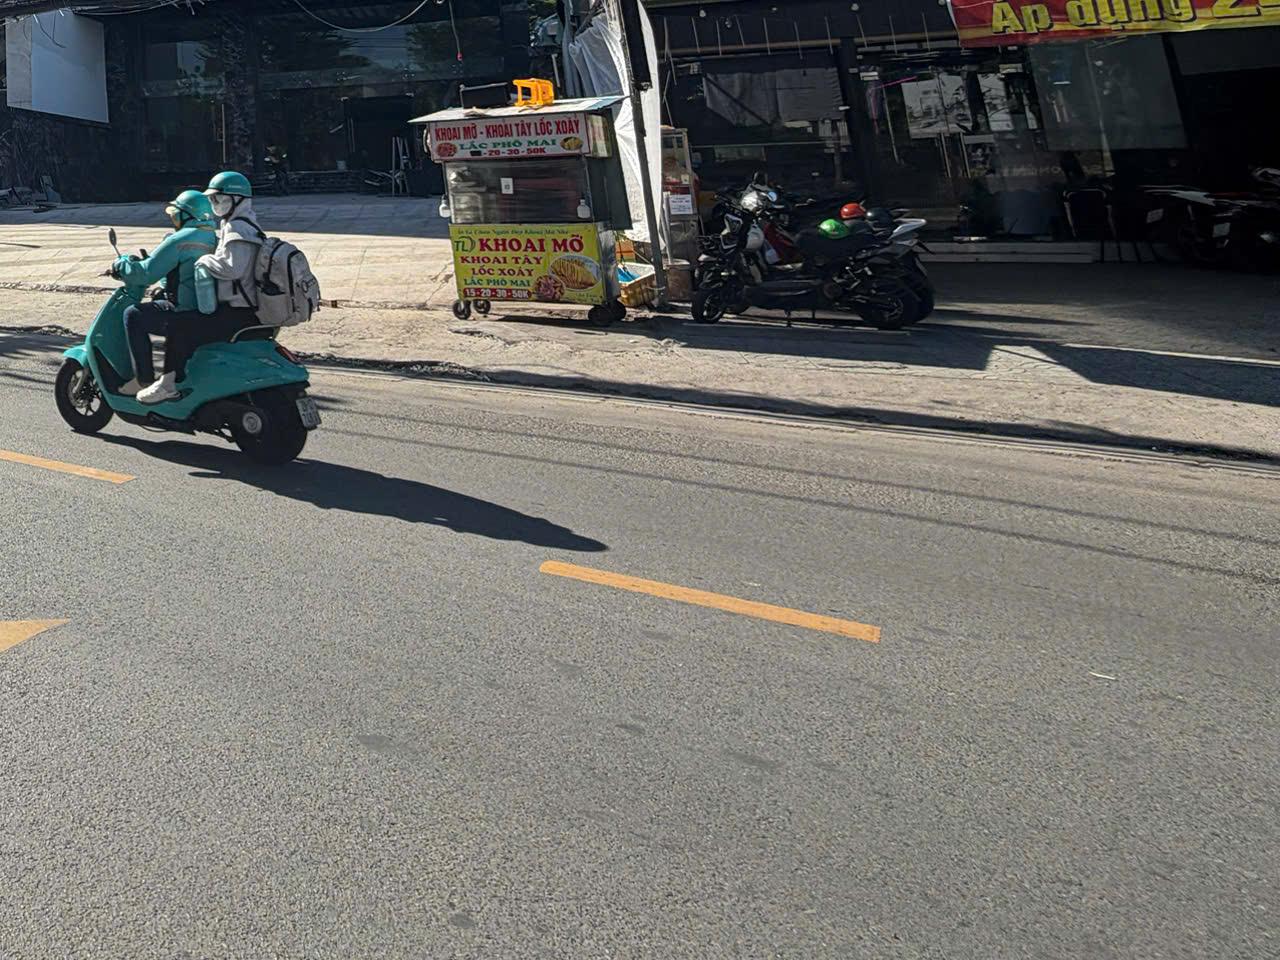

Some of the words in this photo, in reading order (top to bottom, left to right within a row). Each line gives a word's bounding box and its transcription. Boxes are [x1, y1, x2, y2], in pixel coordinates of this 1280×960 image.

[435, 126, 460, 141] KHOAI
[485, 123, 511, 139] KHOAI
[514, 120, 531, 137] TÂY
[527, 139, 556, 148] MAI
[479, 237, 546, 253] KHOAI
[460, 256, 507, 265] KHOAI
[511, 254, 543, 265] TÂY
[510, 279, 531, 287] MAI
